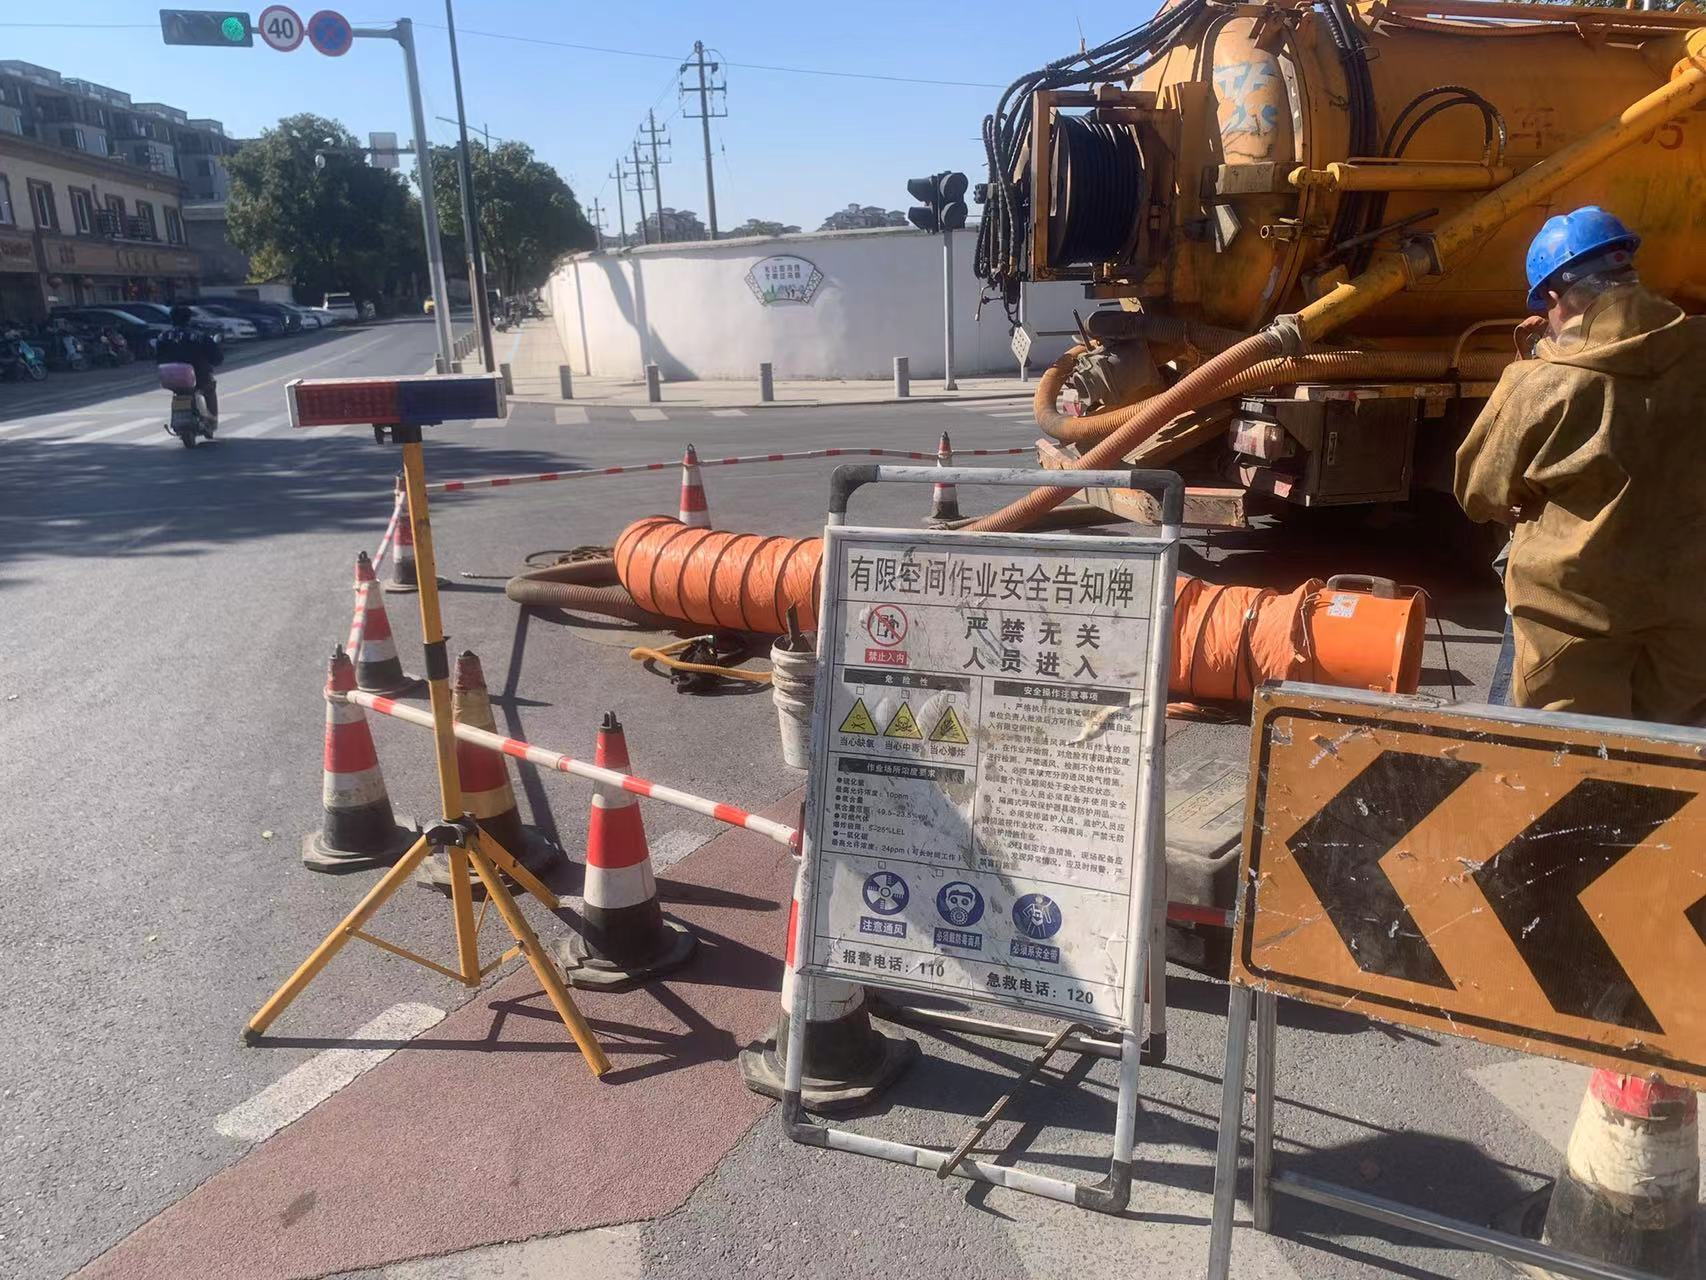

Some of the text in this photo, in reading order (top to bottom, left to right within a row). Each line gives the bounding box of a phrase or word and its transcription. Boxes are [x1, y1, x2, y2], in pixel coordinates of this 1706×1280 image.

[268, 18, 294, 39] 40
[850, 555, 1134, 609] 有限空间作业安全告知牌
[964, 616, 1100, 650] 严禁无关
[867, 650, 905, 664] 禁止入内
[962, 646, 1099, 680] 人员进入
[885, 674, 929, 687] 危险性
[1023, 686, 1099, 702] 安全操作注意事项
[866, 763, 936, 778] 作业场所浓度要求
[862, 919, 904, 936] 注意通风
